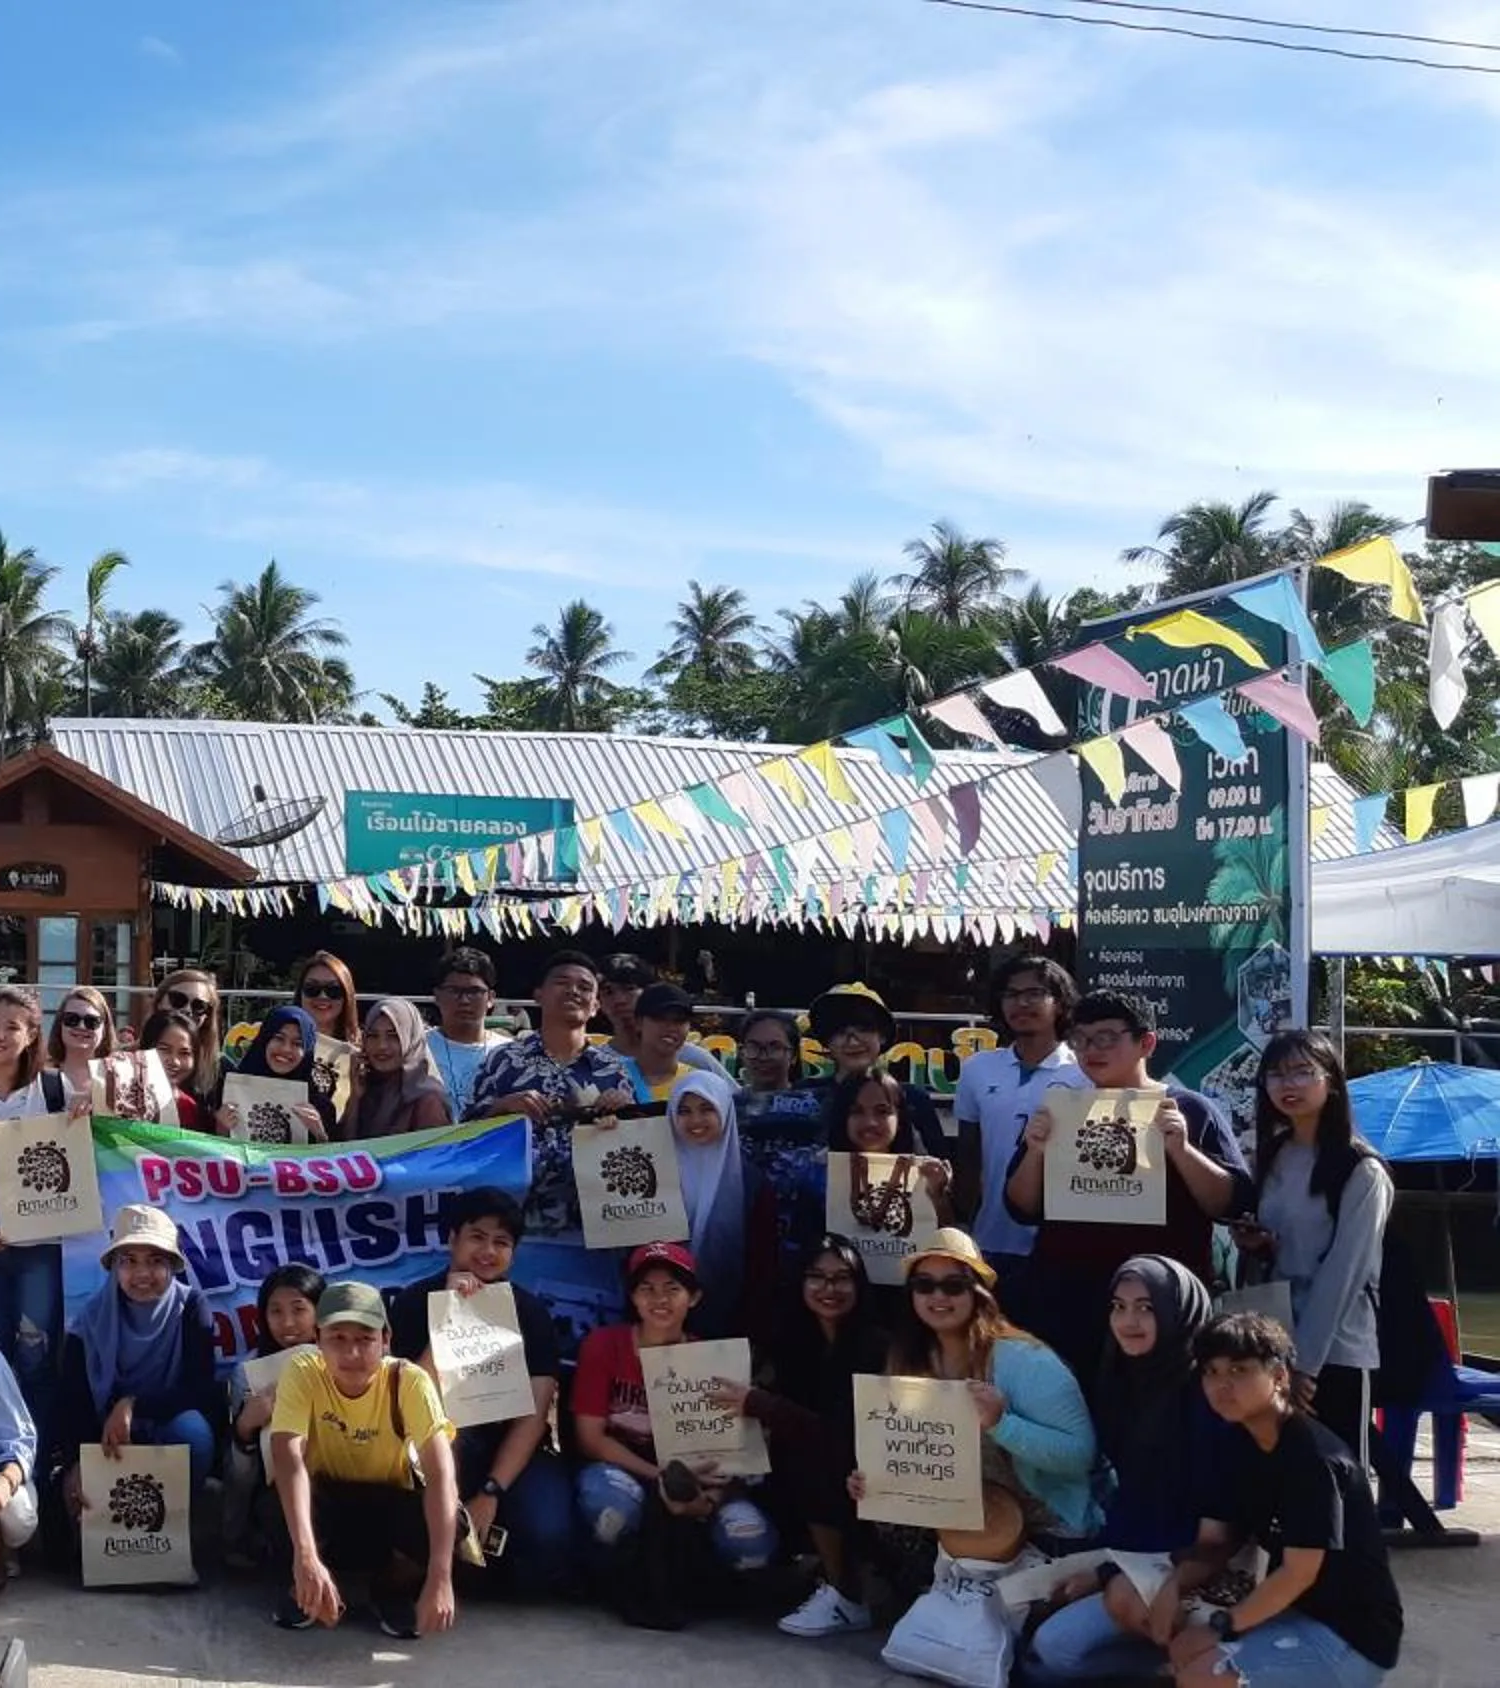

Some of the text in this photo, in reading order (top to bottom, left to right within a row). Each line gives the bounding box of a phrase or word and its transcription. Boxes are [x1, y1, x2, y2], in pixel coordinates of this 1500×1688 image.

[1083, 862, 1165, 902] จุดบริการ
[139, 1153, 378, 1202] PSU-BSU
[1068, 1174, 1143, 1197] Amantra
[175, 1188, 458, 1291] NGLISH
[103, 1534, 172, 1557] Amantra
